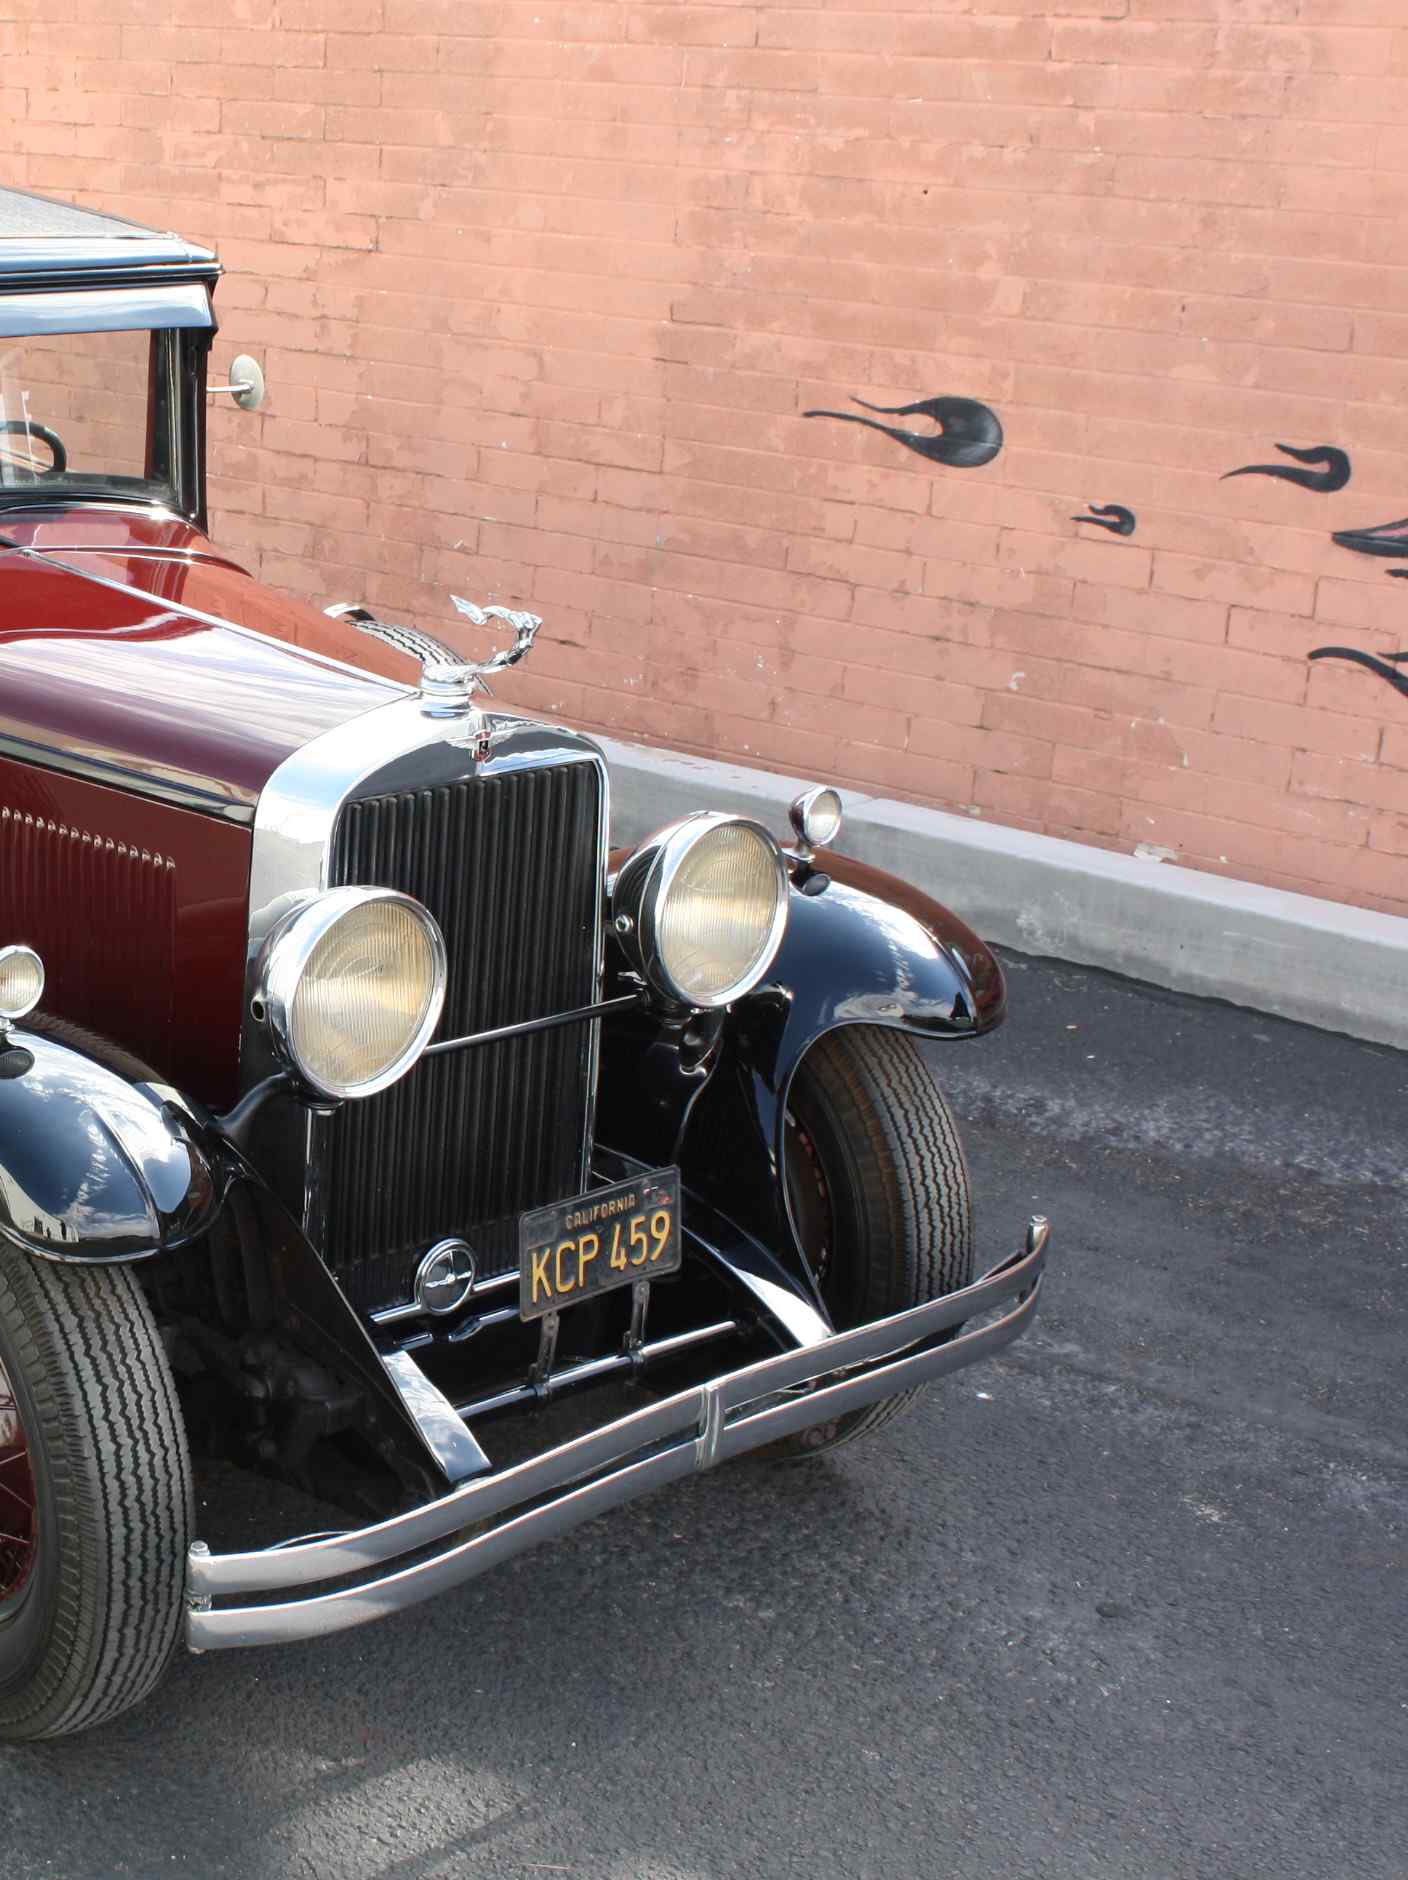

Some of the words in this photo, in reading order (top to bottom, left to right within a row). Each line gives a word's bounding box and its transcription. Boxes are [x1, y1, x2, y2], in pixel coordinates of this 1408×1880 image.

[566, 1195, 637, 1230] CALIFORNIA
[531, 1234, 599, 1304] KCP
[610, 1210, 672, 1272] 459
